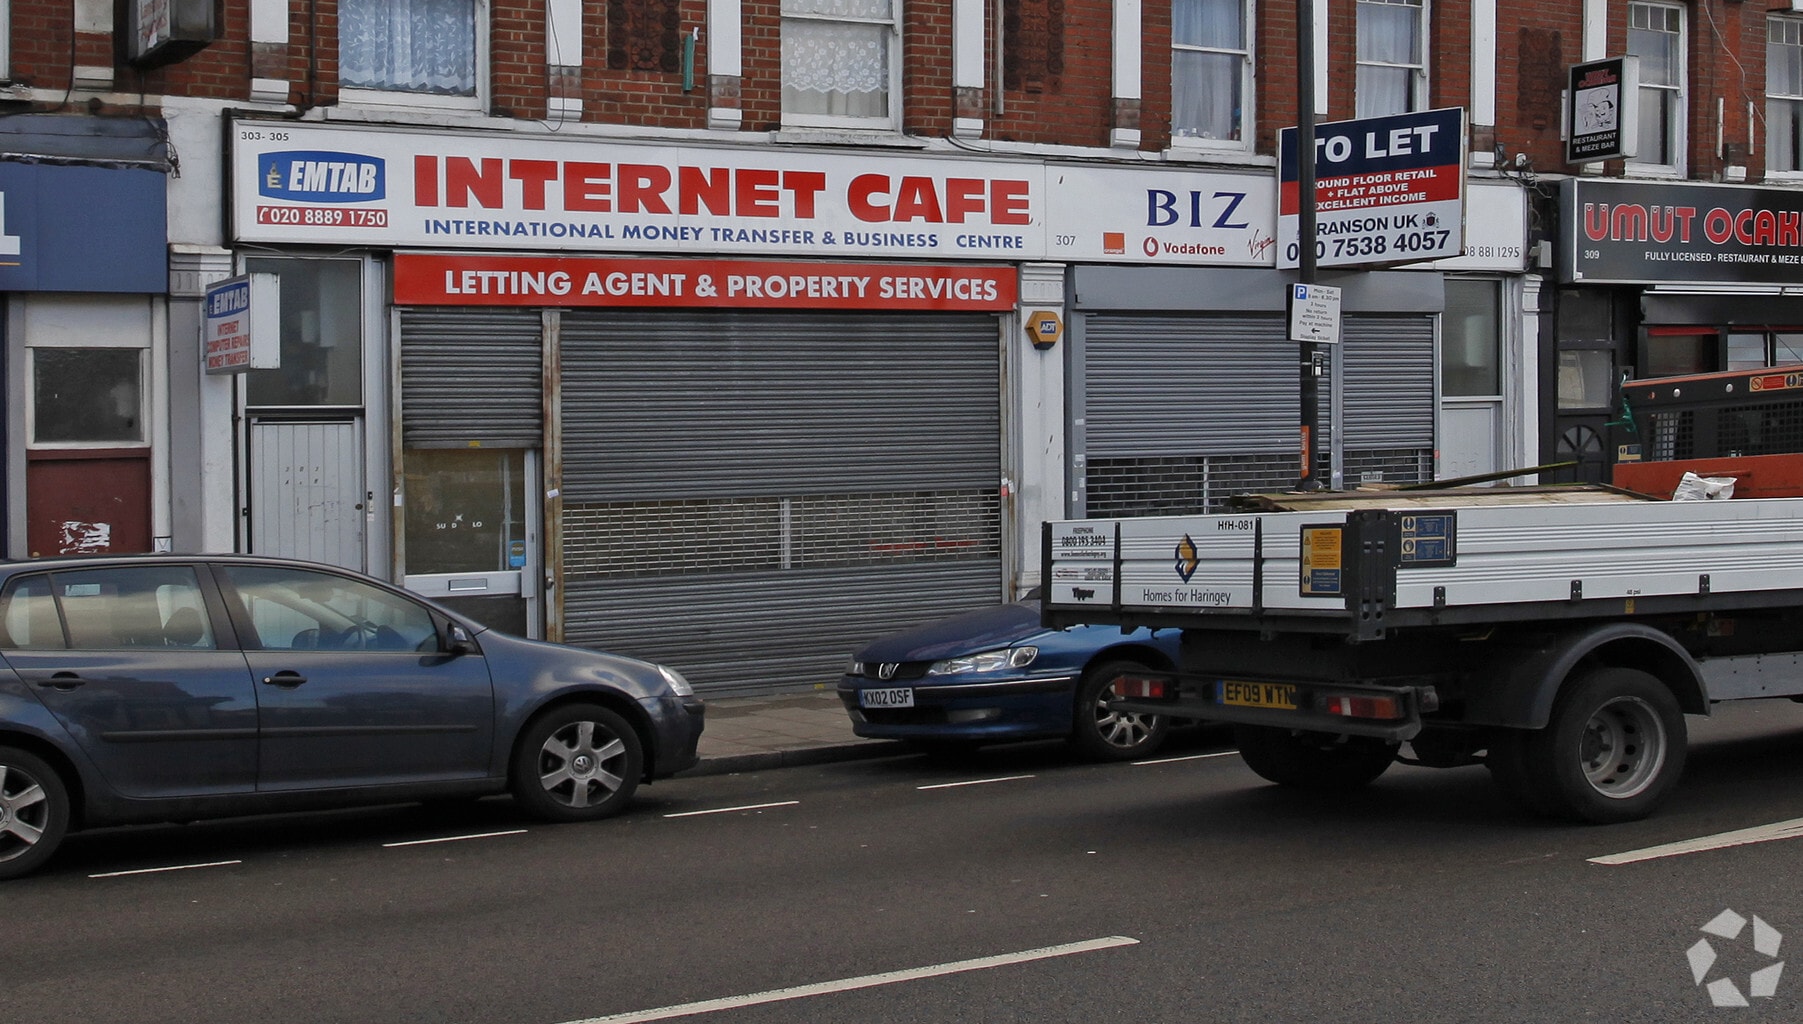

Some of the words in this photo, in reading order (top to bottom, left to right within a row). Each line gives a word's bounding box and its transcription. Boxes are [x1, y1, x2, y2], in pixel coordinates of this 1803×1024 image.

[269, 132, 289, 142] 305
[1365, 124, 1439, 159] LET
[1572, 132, 1616, 144] RESTAURANT
[1581, 143, 1599, 152] MEZE
[1601, 141, 1615, 149] BAR
[288, 160, 377, 194] EMTAB
[1316, 178, 1349, 189] OUND
[1353, 173, 1391, 185] FLOOR
[1395, 169, 1437, 181] RETAIL
[414, 154, 826, 219] INTERNET
[847, 173, 1030, 225] CAFE
[1327, 190, 1334, 198] +
[1337, 187, 1366, 198] FLAT
[1368, 182, 1409, 194] ABOVE
[1146, 189, 1250, 229] BIZ
[1316, 196, 1376, 210] XCELLENT
[1380, 192, 1426, 205] INCOME
[270, 208, 300, 224] 020
[304, 209, 343, 225] 8889
[349, 210, 386, 226] 1750
[1394, 213, 1419, 229] UK
[1584, 203, 1697, 243] UMUT
[1703, 207, 1803, 247] OCAK
[425, 219, 614, 239] INTERNATIONAL
[622, 225, 704, 241] MONEY
[711, 227, 815, 245] TRANSFER
[822, 231, 836, 245] &
[844, 231, 938, 247] BUSINESS
[956, 234, 1023, 249] CENTRE
[1056, 235, 1076, 246] 307
[1163, 242, 1225, 255] Vodafone
[1286, 240, 1326, 262] 00
[1332, 235, 1387, 258] 7538
[1393, 229, 1450, 252] 4057
[1479, 246, 1494, 257] 881
[1497, 246, 1520, 258] 1295
[1584, 250, 1600, 259] 309
[1645, 251, 1670, 261] FULLY
[1671, 252, 1712, 262] LICENSED
[1717, 253, 1770, 263] RESTAURANT
[1771, 255, 1777, 263] &
[1778, 255, 1800, 264] MEZE
[445, 270, 572, 296] LETTING
[581, 272, 686, 297] AGENT
[695, 274, 719, 297] &
[727, 275, 871, 299] PROPERTY
[879, 276, 998, 301] SERVICES
[213, 286, 248, 315] EMTAB
[217, 320, 240, 336] INTERNET
[1041, 323, 1056, 331] ADT
[208, 354, 224, 368] MONEY
[225, 350, 248, 365] TRANSFER
[1217, 520, 1253, 530] HfH-081
[1143, 588, 1172, 602] Homes
[1174, 588, 1188, 602] for
[1190, 588, 1232, 606] Haringey
[863, 690, 888, 705] KX02
[890, 689, 910, 704] OSF
[1225, 683, 1260, 703] EF09
